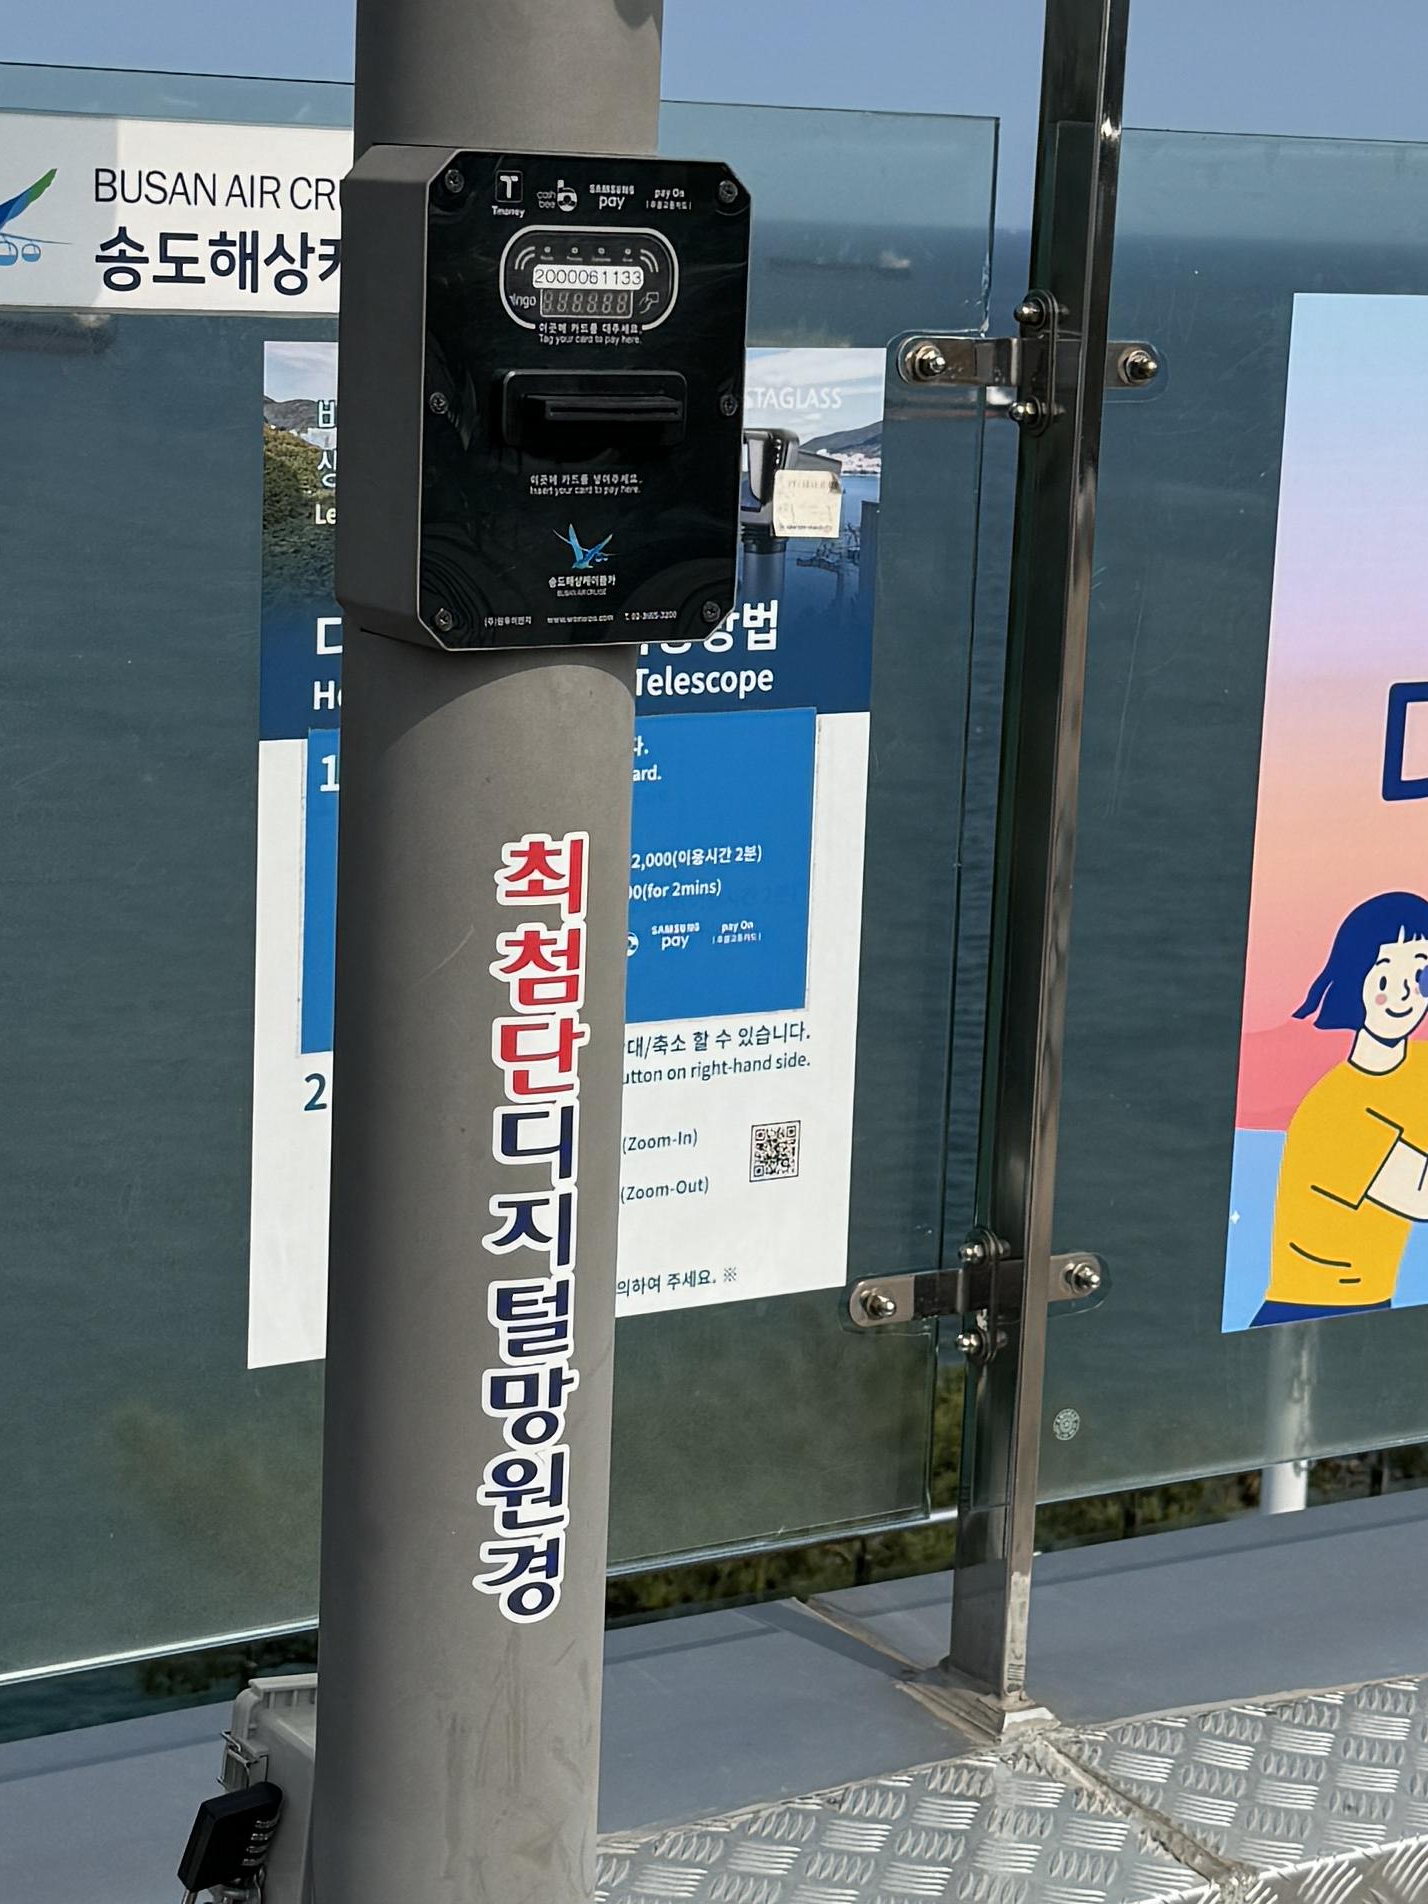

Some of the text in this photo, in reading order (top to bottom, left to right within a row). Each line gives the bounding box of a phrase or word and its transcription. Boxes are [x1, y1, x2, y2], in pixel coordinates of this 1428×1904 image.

[94, 168, 218, 207] BUSAN
[224, 174, 281, 209] AIR
[589, 184, 634, 195] SAMSUNG
[654, 189, 670, 199] pay
[491, 205, 525, 219] Tmoney
[599, 196, 625, 210] pay
[534, 269, 642, 285] 2000061133
[735, 845, 762, 863] 2분)
[672, 879, 722, 897] 2mins)
[651, 922, 700, 935] SAMSUNG
[721, 920, 754, 934] pay On
[661, 934, 690, 950] pay
[623, 1021, 811, 1059] 대/축소 할 수 있습니다.
[667, 1067, 686, 1081] on
[691, 1054, 772, 1081] right-hand
[775, 1052, 811, 1069] side.
[303, 1071, 329, 1113] 2
[622, 1128, 698, 1155] (Zoom-In)
[621, 1176, 709, 1204] (Zoom-Out)
[667, 1268, 717, 1291] 주세요.
